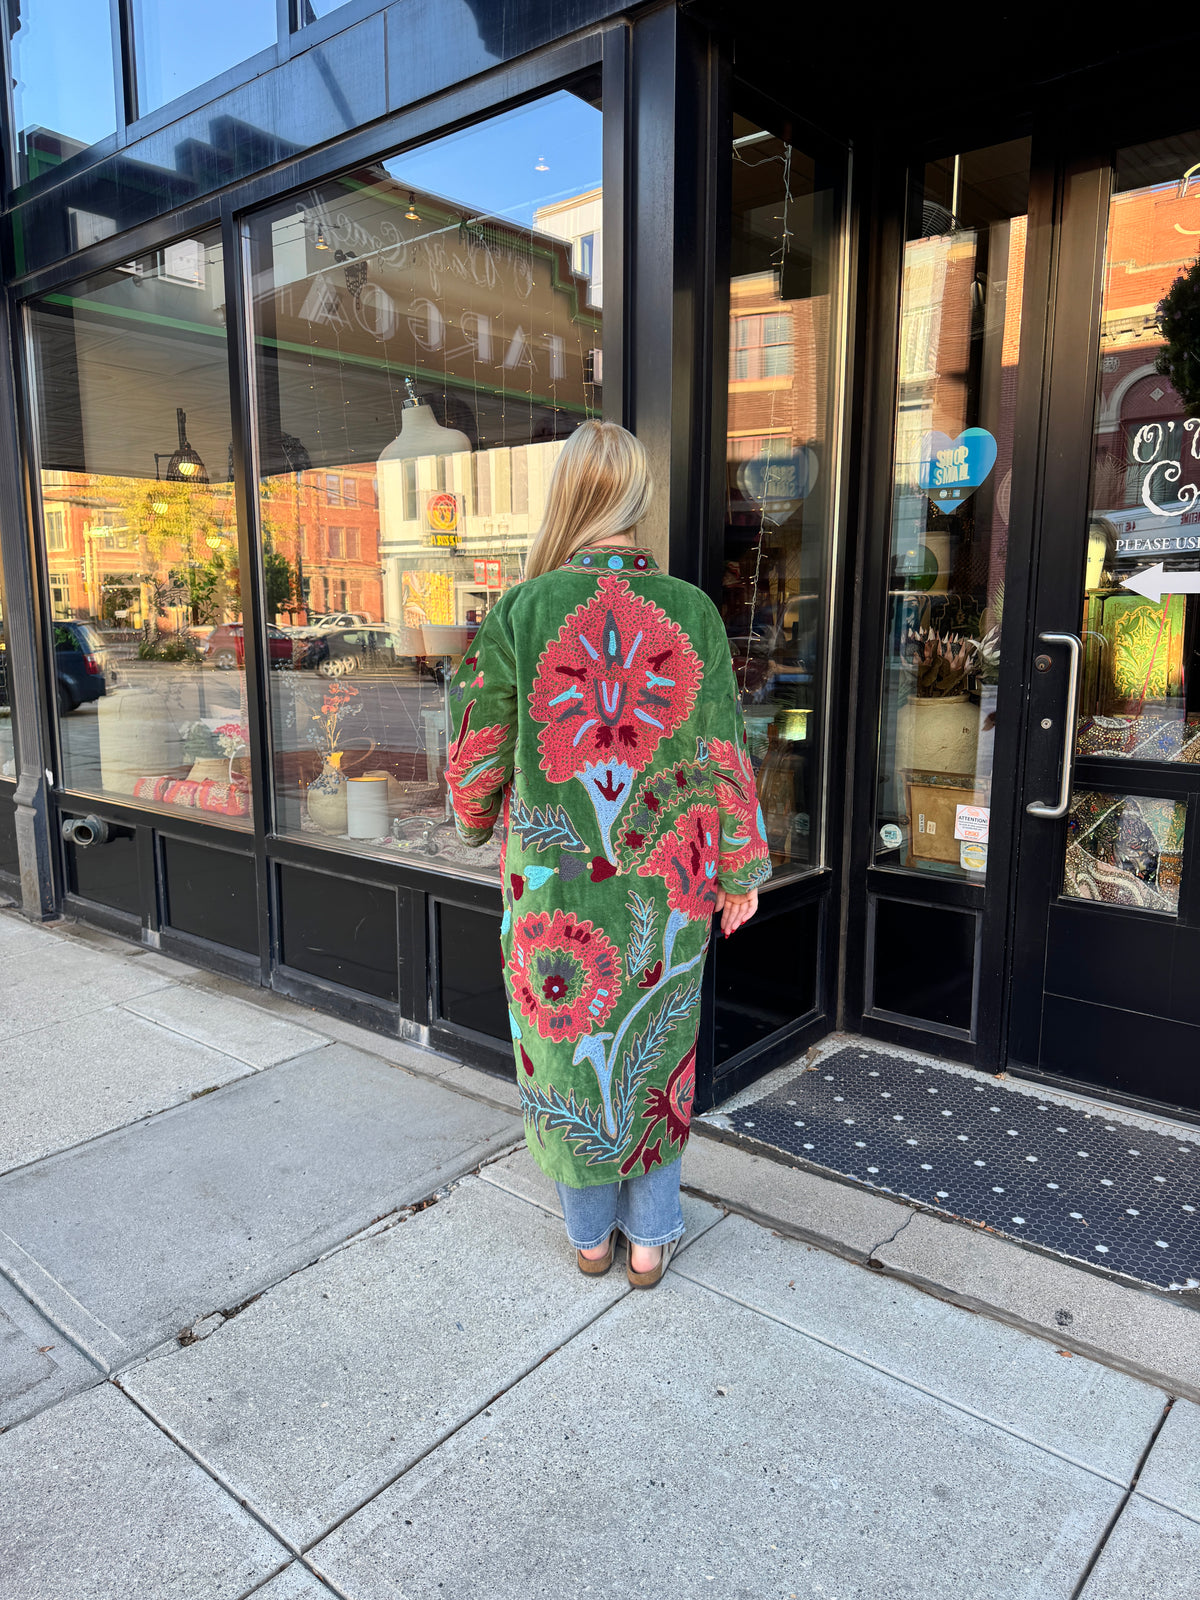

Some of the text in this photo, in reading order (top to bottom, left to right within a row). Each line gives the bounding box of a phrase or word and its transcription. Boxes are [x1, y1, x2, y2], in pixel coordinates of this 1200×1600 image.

[935, 445, 969, 468] SHOP
[934, 463, 970, 486] SMALL
[1115, 538, 1171, 552] PLEASE
